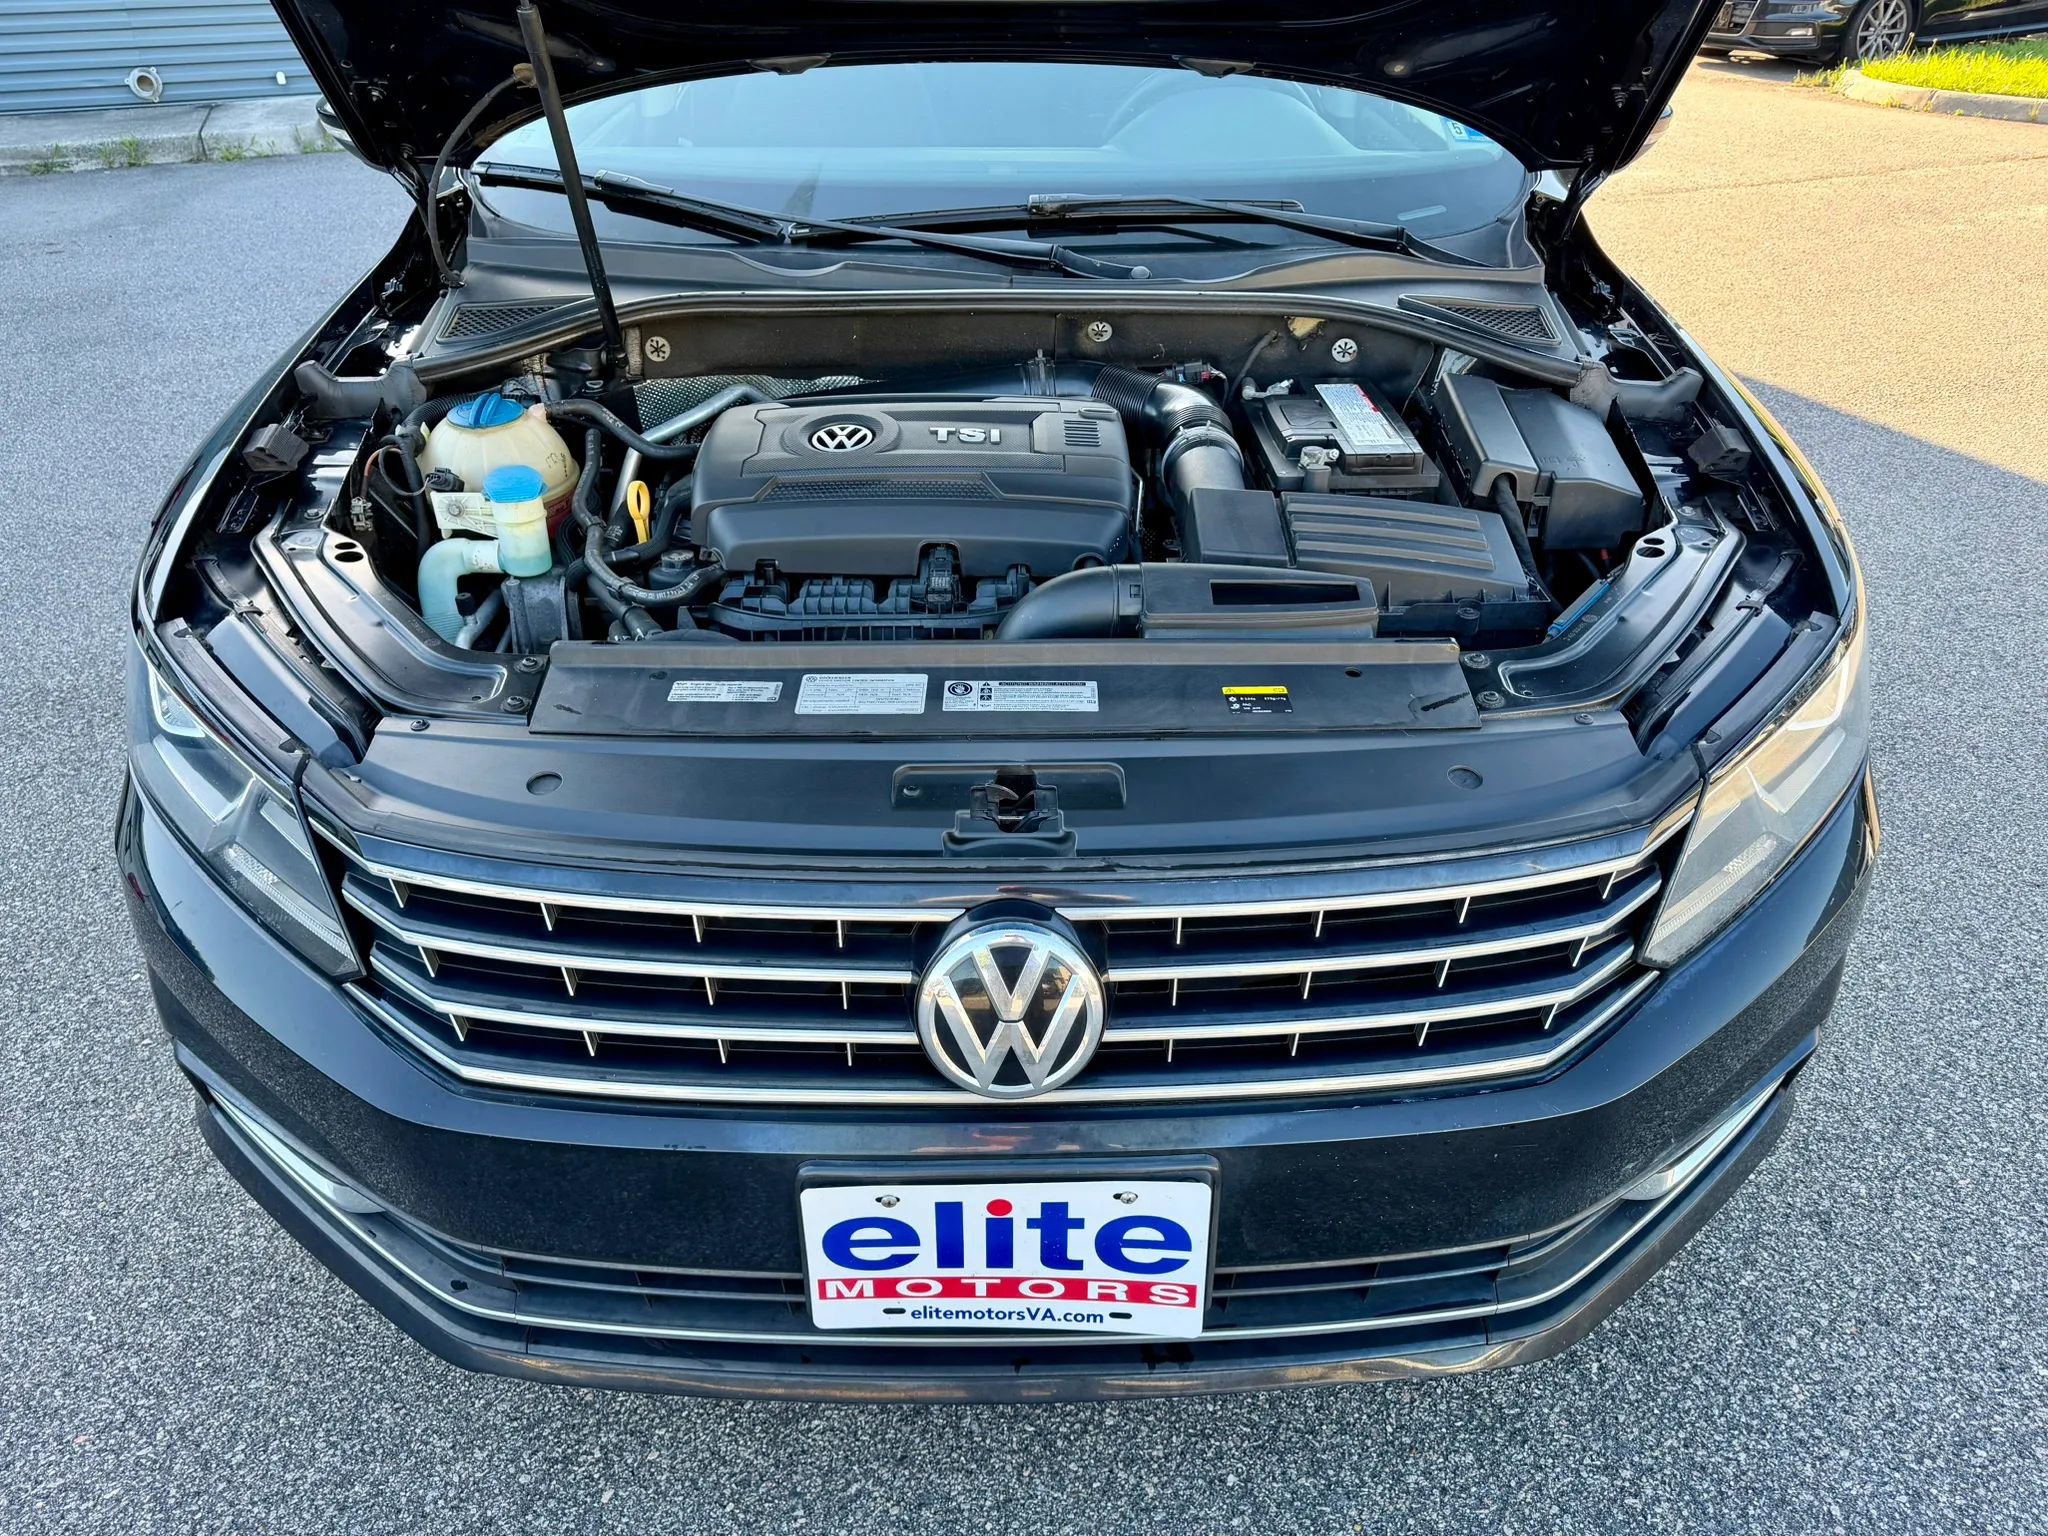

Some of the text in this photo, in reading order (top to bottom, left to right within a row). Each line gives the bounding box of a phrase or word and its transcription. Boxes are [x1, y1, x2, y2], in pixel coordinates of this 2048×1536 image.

[1452, 122, 1463, 135] 5
[929, 426, 1002, 444] TSI
[822, 1199, 1192, 1274] elite
[824, 1279, 1191, 1306] MOTORS
[911, 1306, 1104, 1324] elitemotorsVA.com
